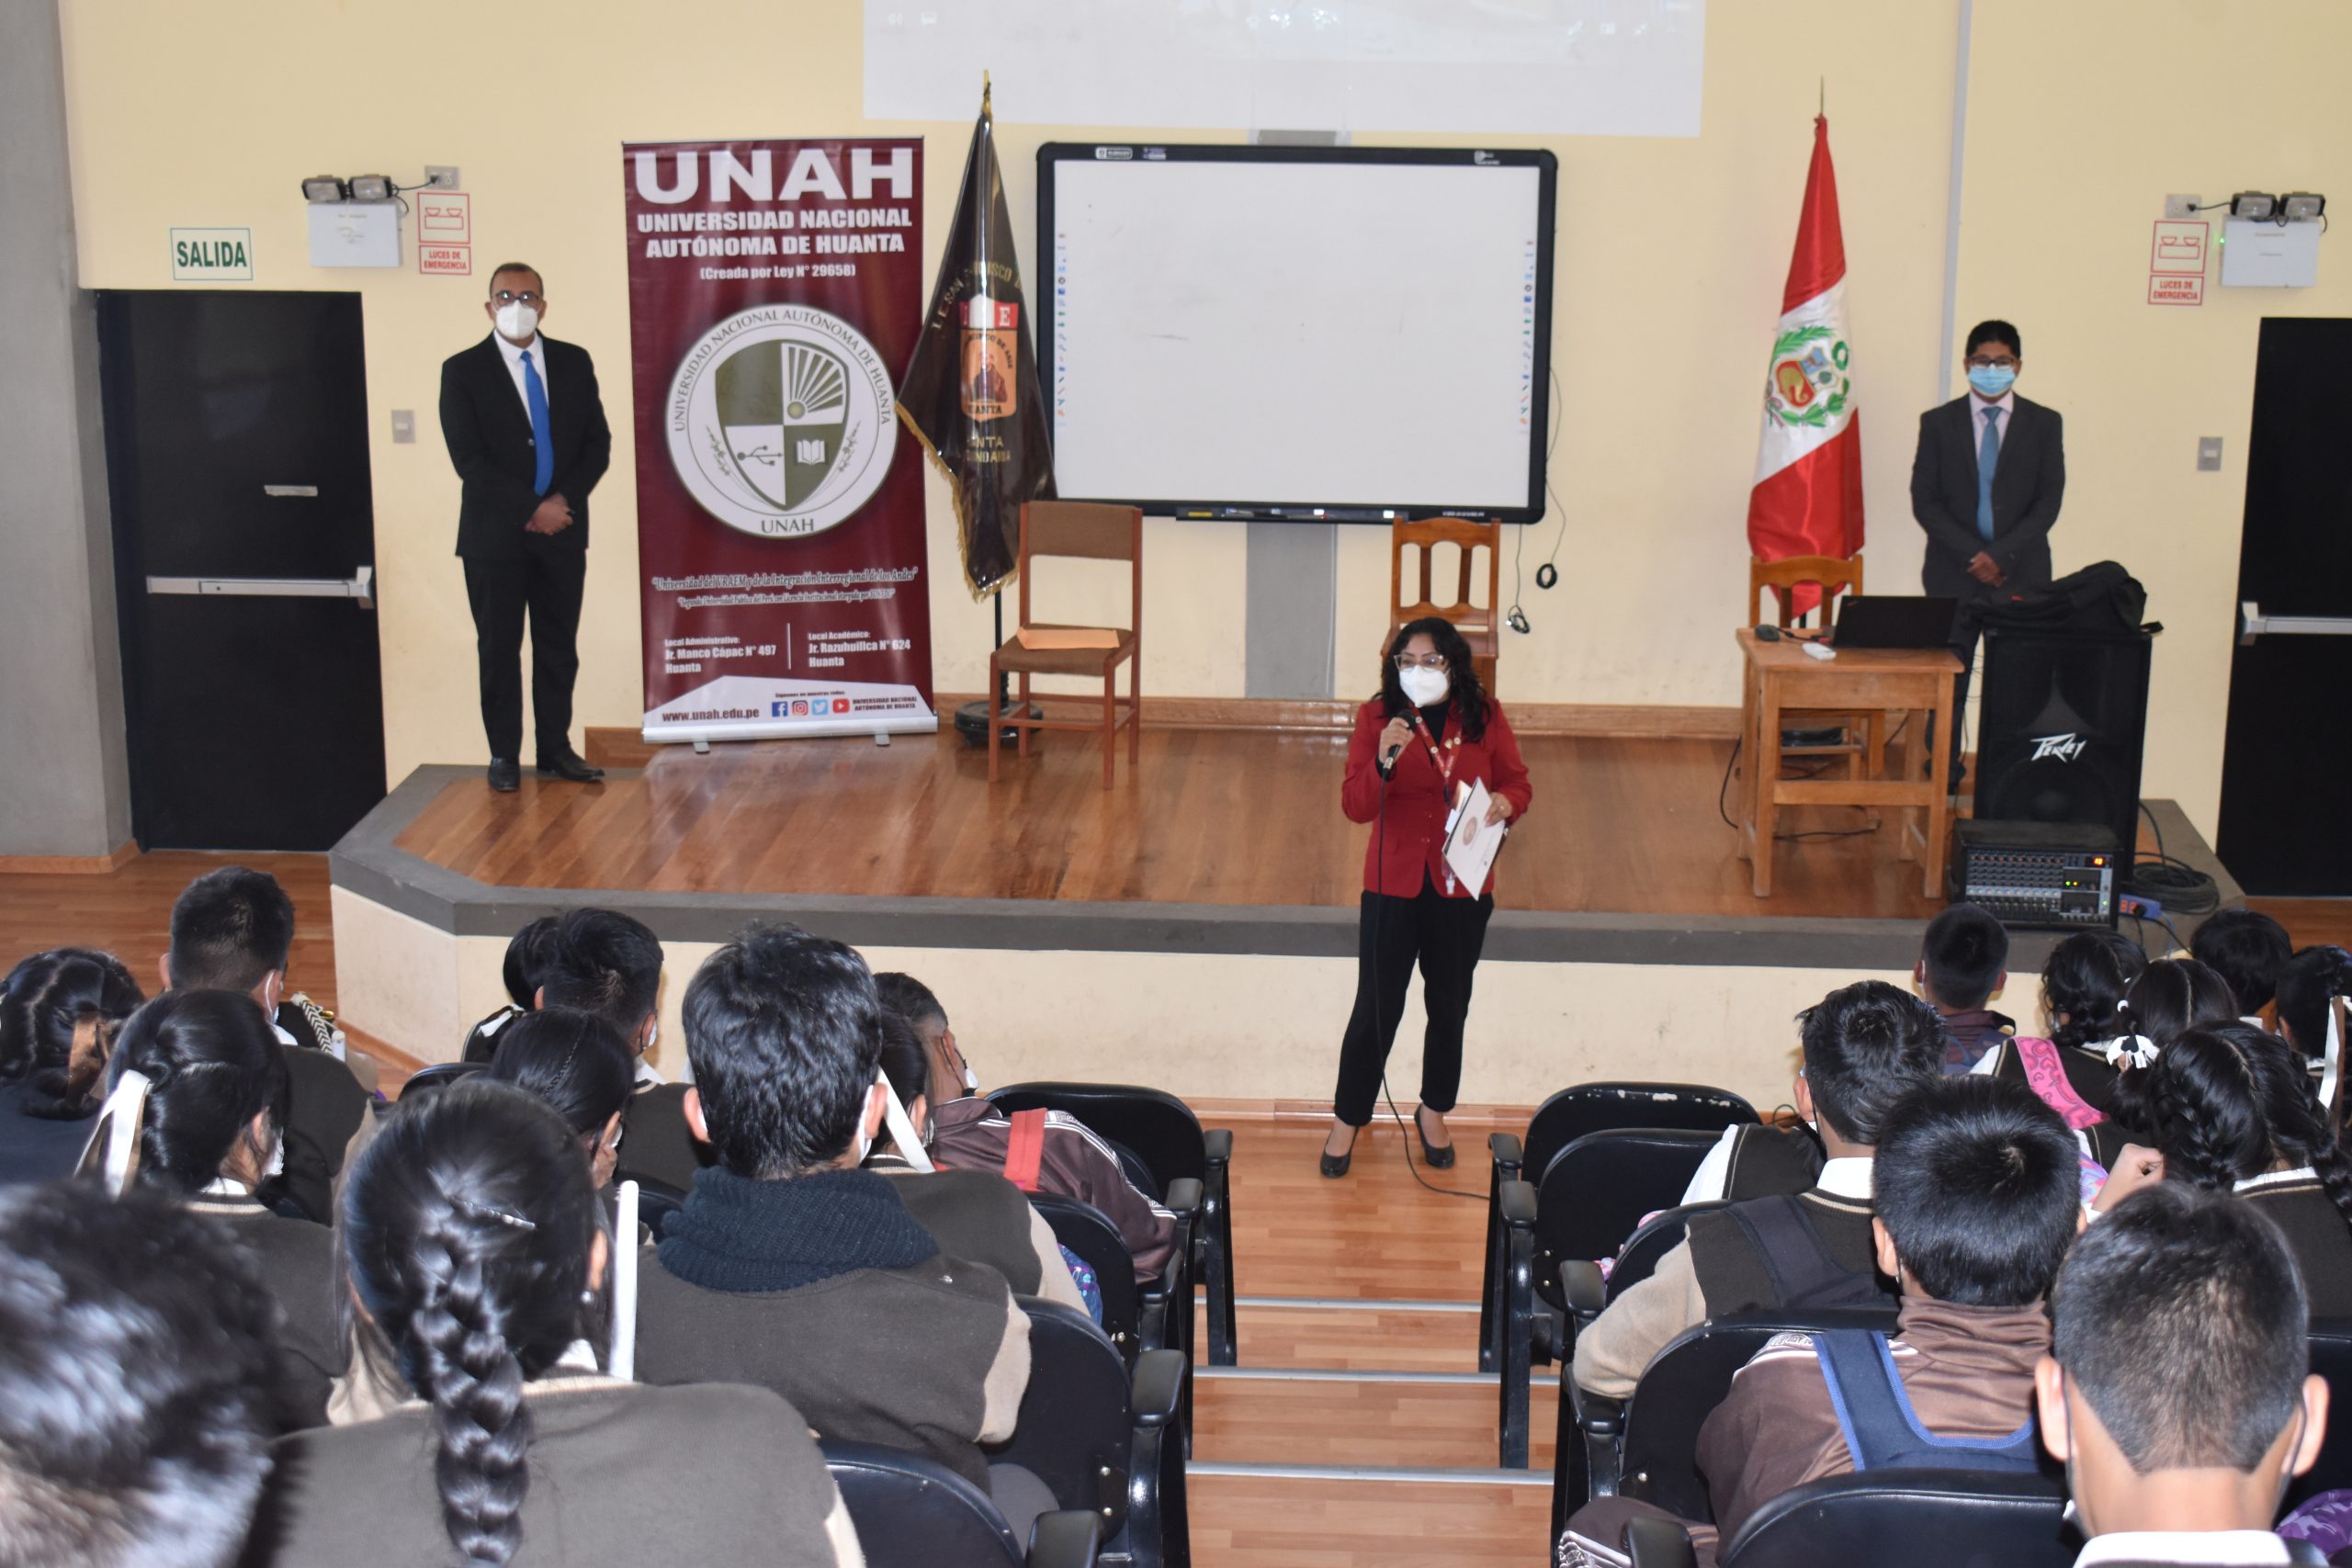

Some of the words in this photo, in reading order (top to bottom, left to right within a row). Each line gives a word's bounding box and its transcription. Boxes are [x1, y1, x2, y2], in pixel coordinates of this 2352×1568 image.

[635, 147, 912, 204] UNAH
[638, 210, 794, 232] UNIVERSIDAD
[800, 209, 912, 229] NACIONAL
[646, 235, 777, 258] AUTÓNOMA
[782, 236, 810, 254] DE
[816, 233, 905, 254] HUANTA
[176, 241, 247, 267] SALIDA
[424, 260, 467, 269] EMERGENCIA
[700, 266, 748, 280] (Creada
[751, 268, 773, 280] por
[774, 266, 795, 279] Ley
[812, 265, 856, 276] 29658)
[2184, 281, 2193, 289] DE
[2154, 290, 2198, 299] EMERGENCIA
[999, 306, 1011, 326] E
[674, 343, 712, 432] UNIVERSIDAD
[711, 310, 779, 345] NACIONAL
[783, 310, 860, 351] AUTÓNOMA
[858, 348, 876, 368] DE
[869, 367, 891, 425] HUANTA
[761, 518, 815, 534] UNAH
[665, 638, 684, 647] Local
[808, 632, 828, 640] Local
[665, 649, 676, 660] Jr.
[677, 649, 711, 659] Manco
[712, 647, 744, 659] Cápac
[758, 645, 777, 656] 497
[808, 643, 820, 654] Jr.
[891, 638, 911, 650] 624
[665, 662, 702, 674] Huanta
[808, 656, 845, 668] Huanta
[662, 707, 760, 722] www.unah.edu.pe
